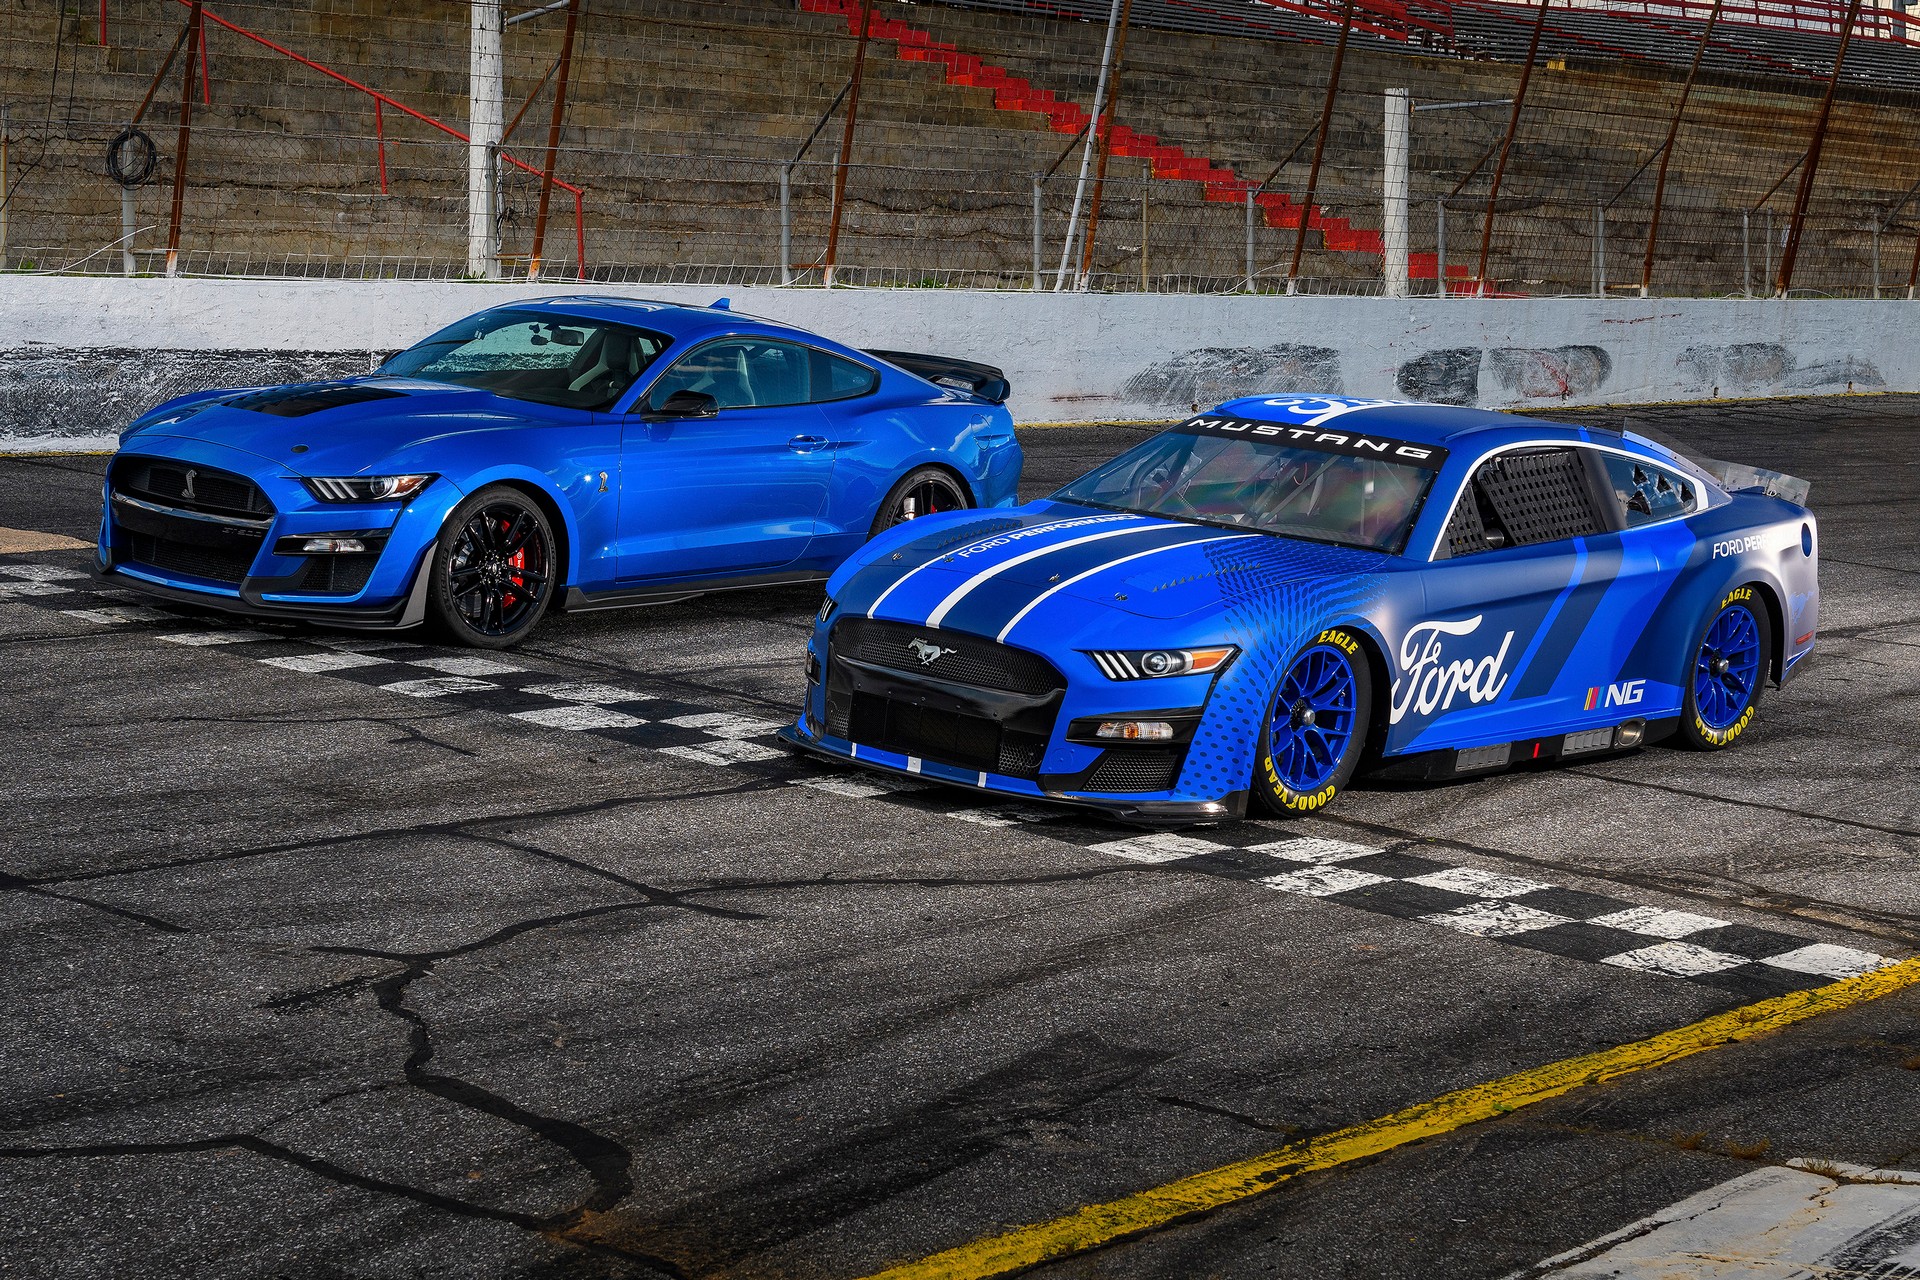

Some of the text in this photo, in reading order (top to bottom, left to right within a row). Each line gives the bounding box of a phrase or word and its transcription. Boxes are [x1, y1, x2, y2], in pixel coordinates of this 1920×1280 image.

[1187, 418, 1432, 460] MUSTANG
[957, 536, 1011, 558] FORD
[1712, 538, 1744, 560] FORD
[1721, 587, 1753, 610] EAGLE
[1317, 629, 1359, 656] EAGLE
[1390, 614, 1515, 725] Ford
[1604, 679, 1646, 708] NG
[1695, 705, 1755, 747] GOODYEAR
[1264, 755, 1336, 811] GOODYEAR
